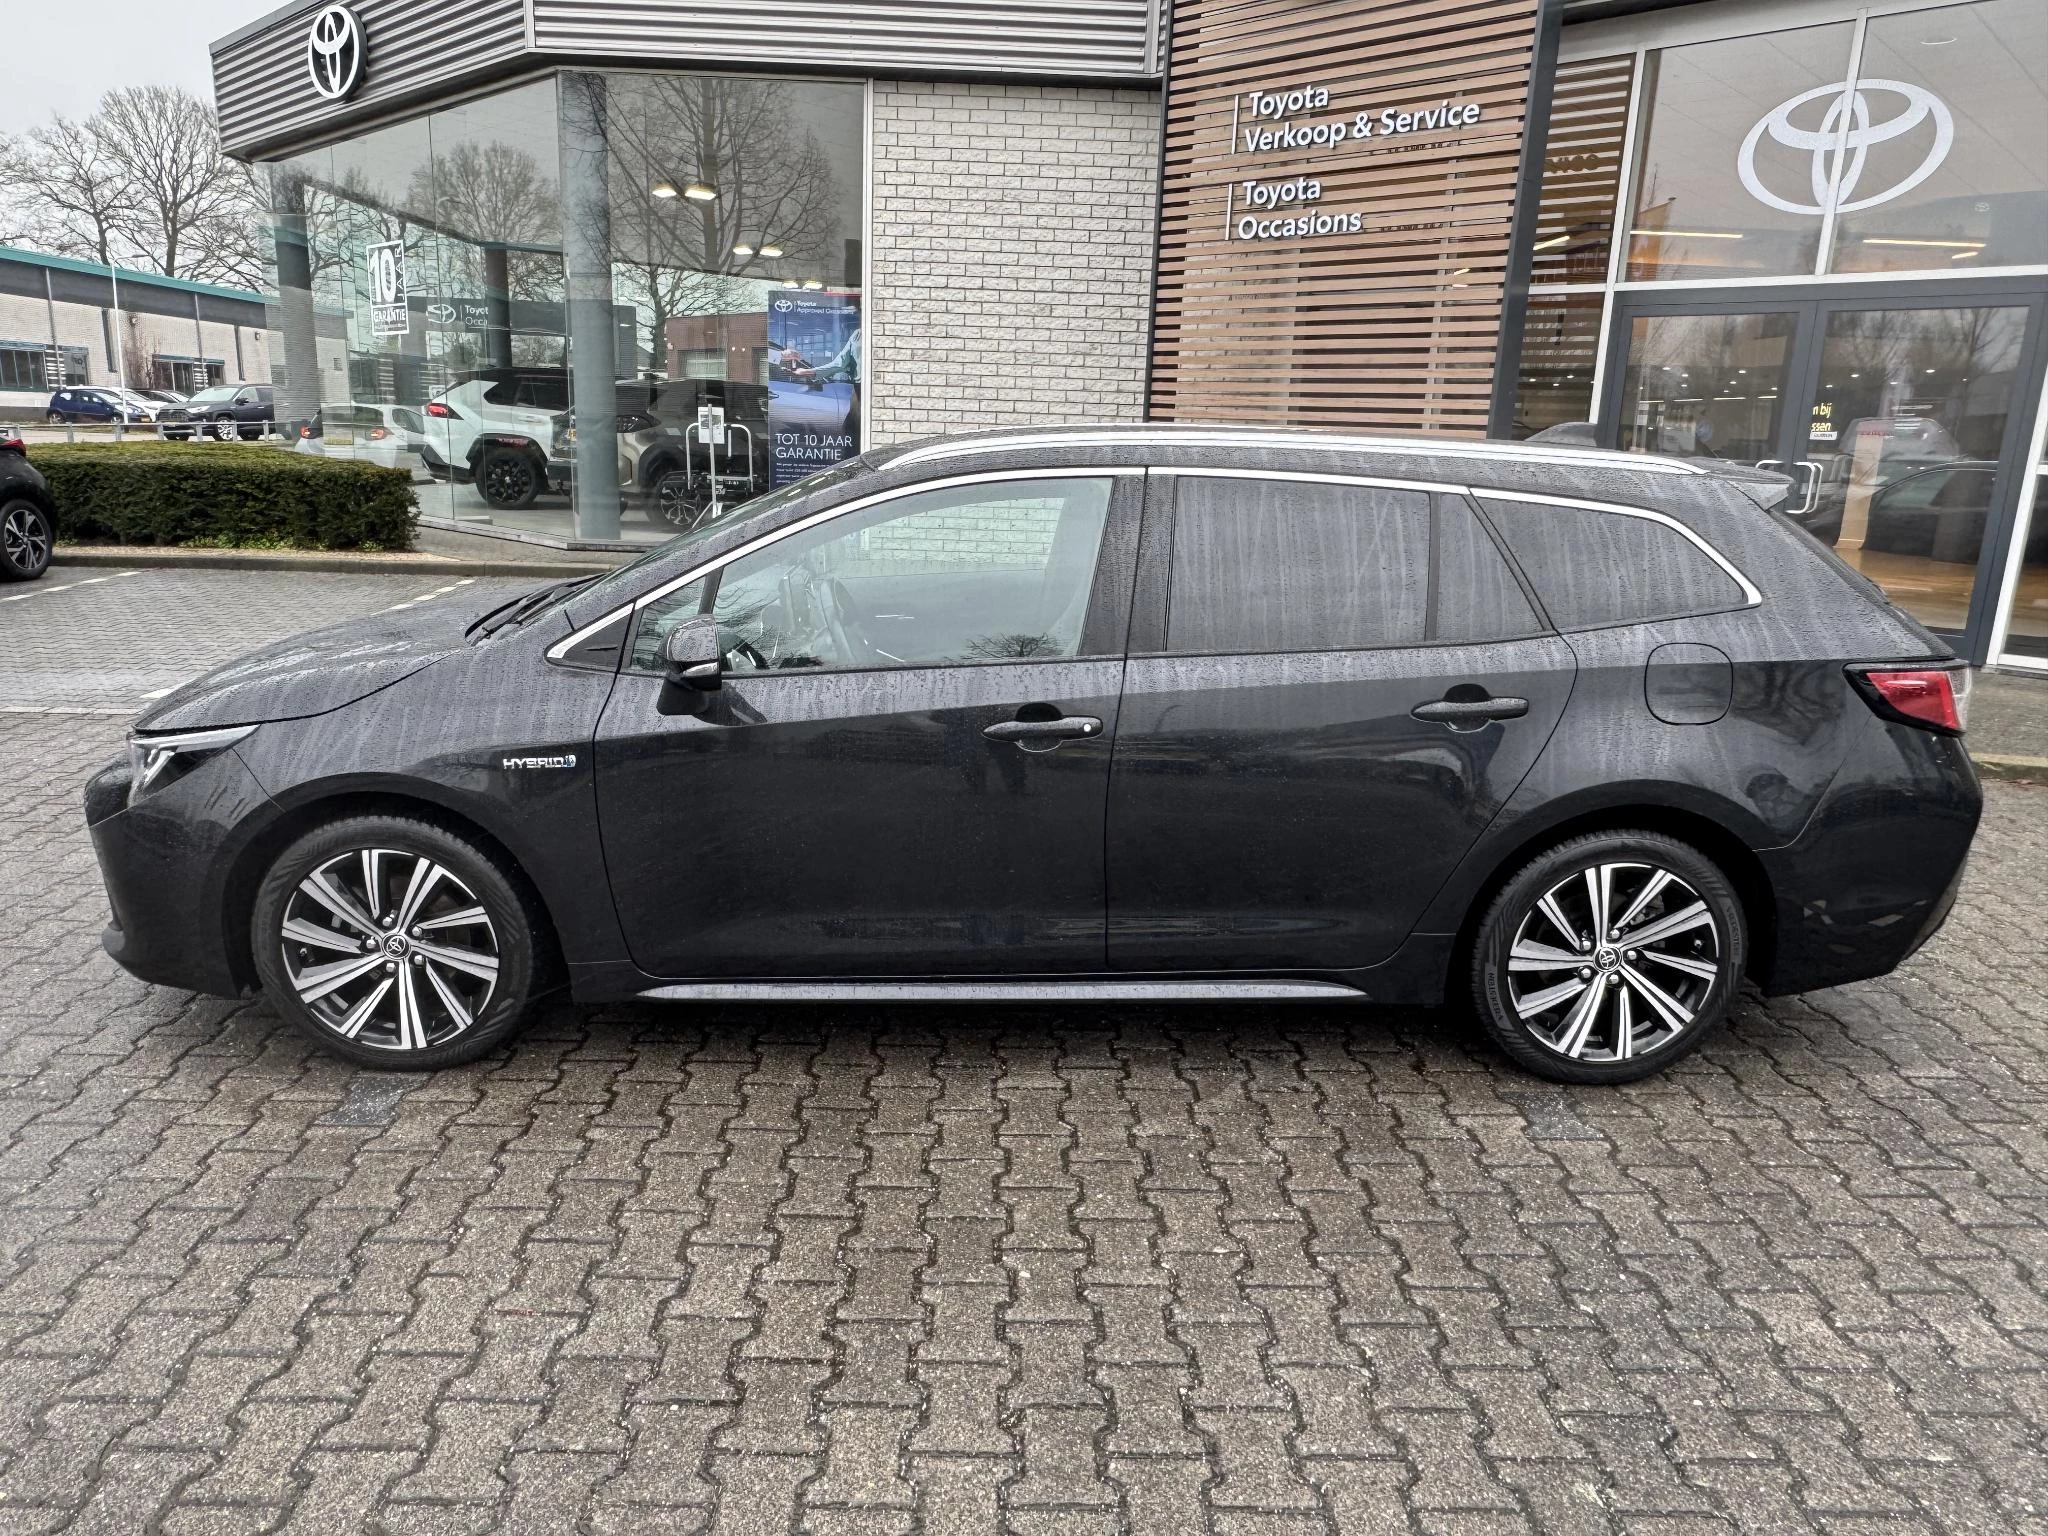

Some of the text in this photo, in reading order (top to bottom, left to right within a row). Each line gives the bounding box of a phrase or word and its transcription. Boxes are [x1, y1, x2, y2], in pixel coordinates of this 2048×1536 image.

[1249, 85, 1330, 119] Toyota
[1245, 100, 1481, 152] Verkoop & Service
[1242, 176, 1322, 210] Toyota
[1237, 209, 1364, 241] Occasions
[370, 248, 396, 304] 10
[394, 245, 406, 301] JAAR
[775, 433, 852, 447] TOT 10 JAAR
[775, 447, 841, 461] GARANTIE
[502, 757, 564, 769] HYBRID
